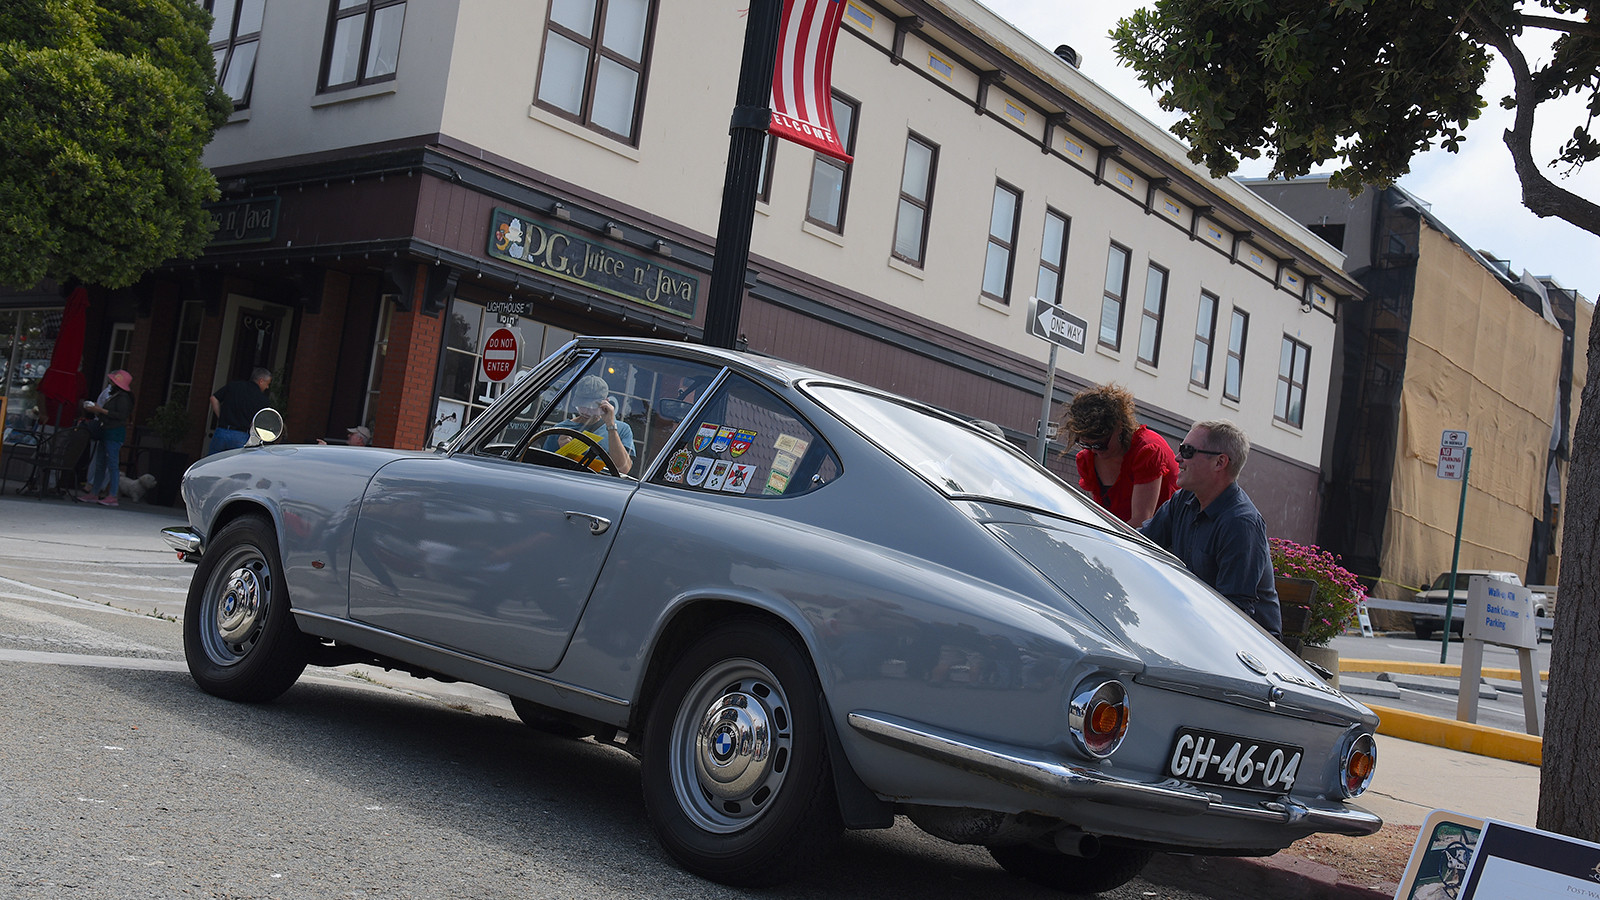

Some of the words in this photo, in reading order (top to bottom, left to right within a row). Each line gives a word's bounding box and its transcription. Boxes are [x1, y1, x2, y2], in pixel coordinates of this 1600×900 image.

[773, 114, 834, 142] ELCOME
[235, 204, 271, 239] Java
[572, 244, 625, 278] Juice
[633, 264, 651, 285] n'
[646, 268, 692, 302] Java
[486, 301, 525, 313] LIGHTHOUSE
[1050, 317, 1066, 335] ONE
[1066, 325, 1082, 341] WAY
[489, 338, 498, 348] DO
[500, 338, 514, 348] NOT
[487, 361, 510, 372] ENTER
[1486, 603, 1500, 614] Bank
[1501, 607, 1519, 618] Customer
[1485, 617, 1506, 631] Parking
[1170, 733, 1301, 790] GH-46-04
[1567, 886, 1600, 900] POST-WA
